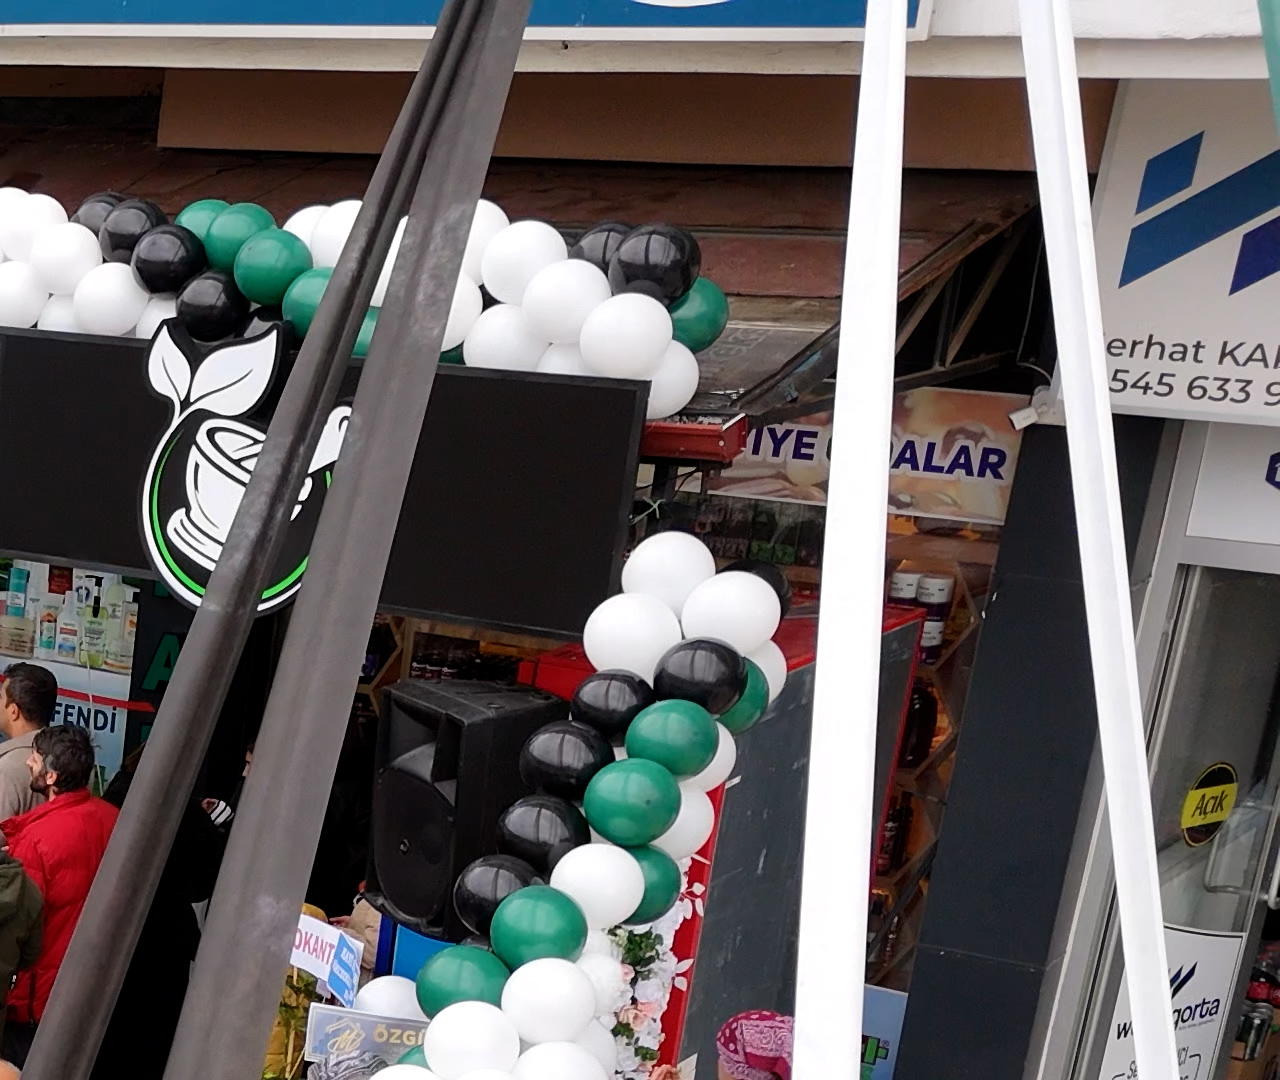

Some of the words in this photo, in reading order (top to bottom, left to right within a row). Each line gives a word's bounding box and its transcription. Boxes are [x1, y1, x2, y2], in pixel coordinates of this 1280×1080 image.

[1105, 333, 1206, 364] erhat
[1108, 368, 1176, 398] 545
[1186, 375, 1254, 404] 633
[49, 701, 117, 734] FENDİ
[1190, 789, 1229, 821] Açık
